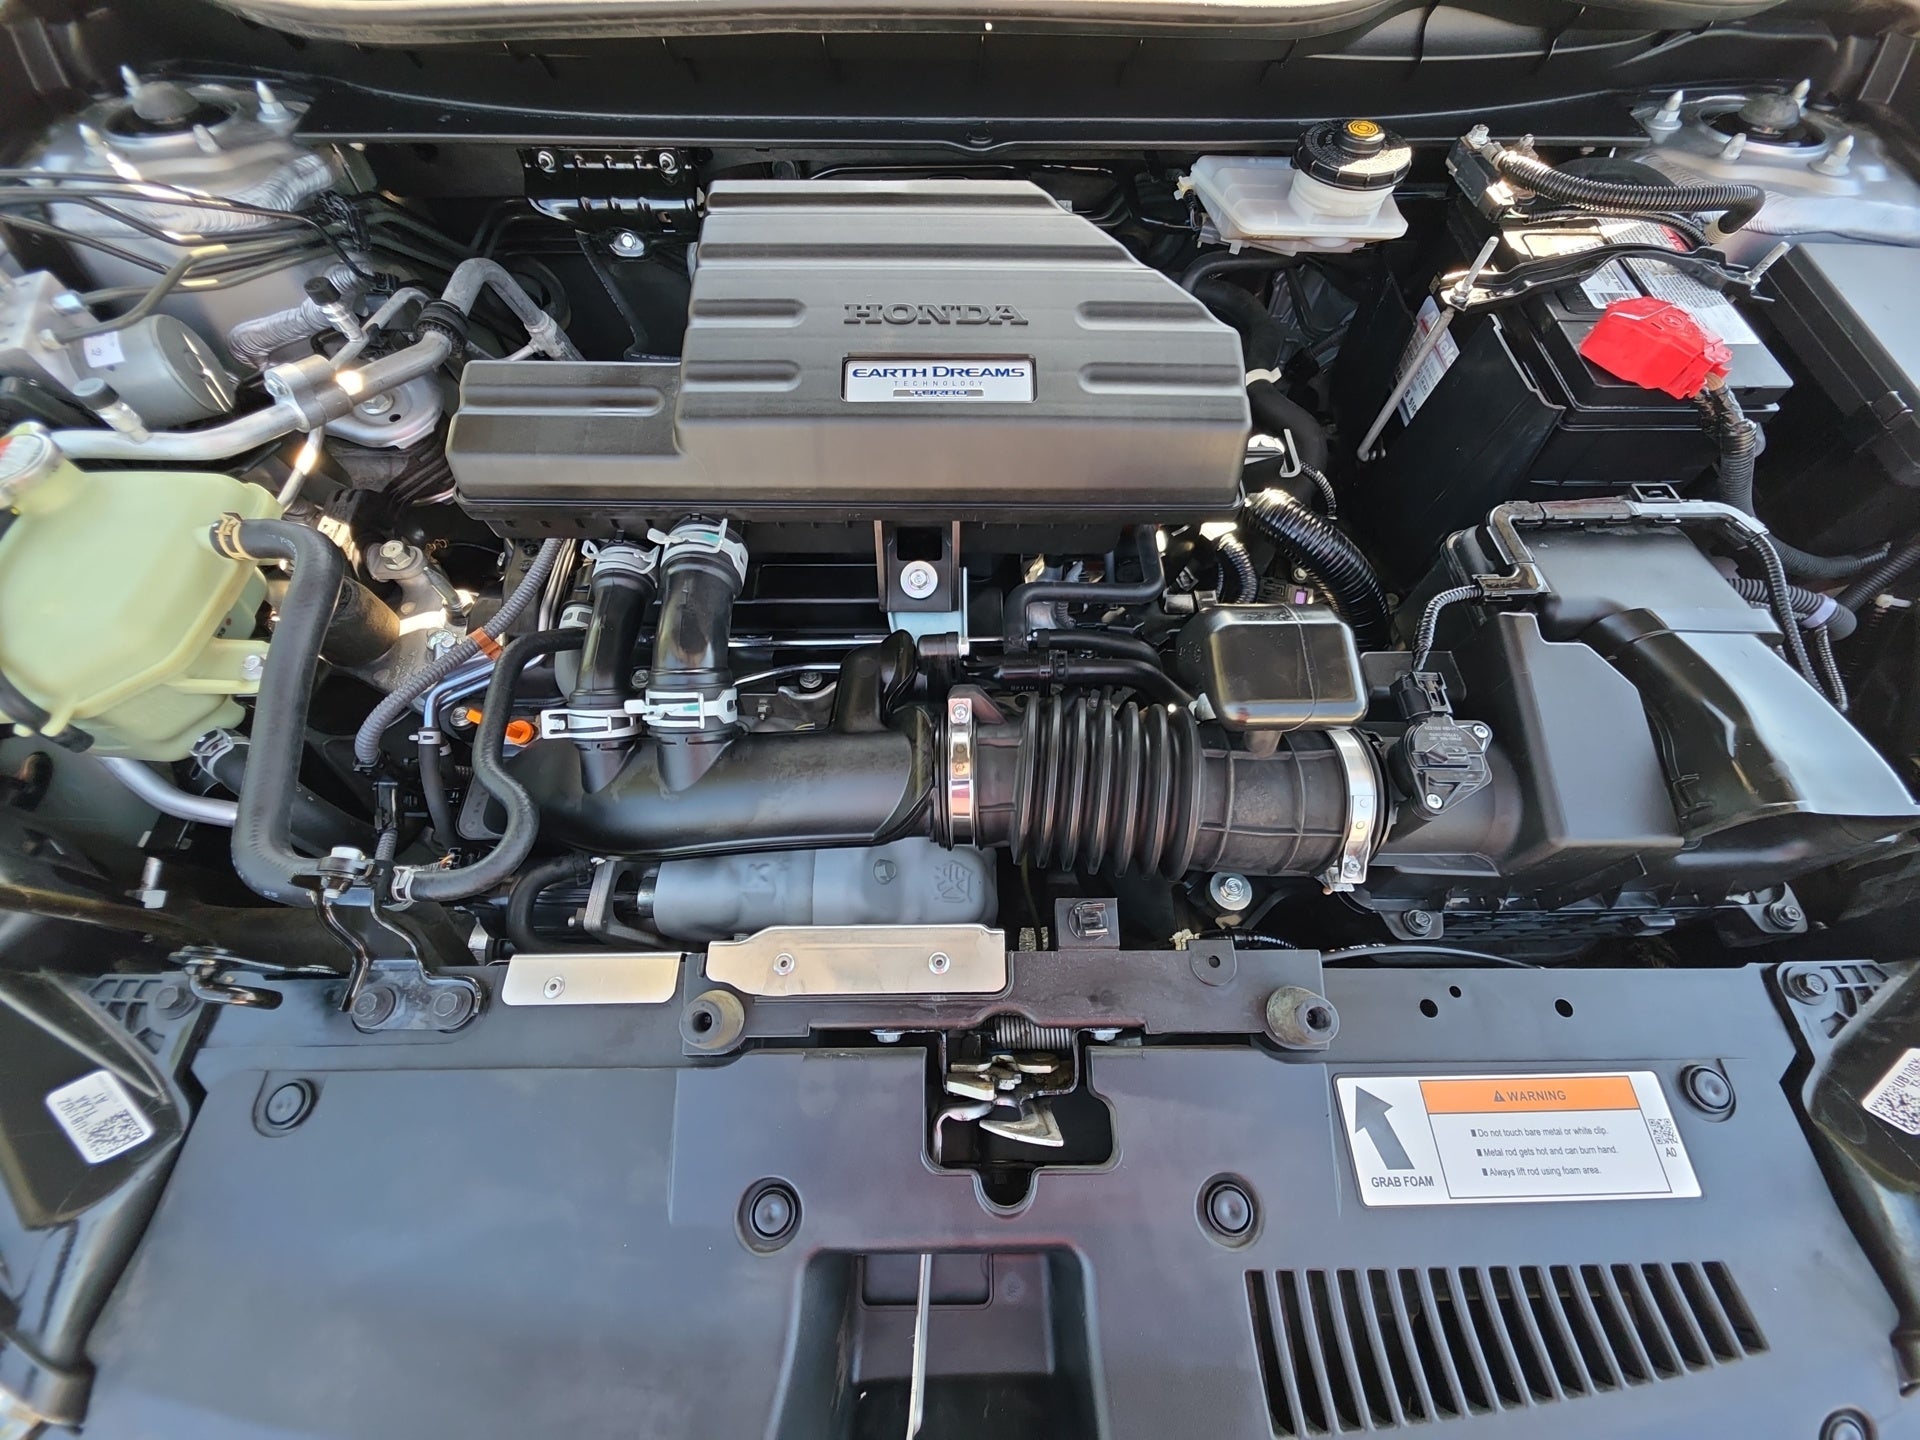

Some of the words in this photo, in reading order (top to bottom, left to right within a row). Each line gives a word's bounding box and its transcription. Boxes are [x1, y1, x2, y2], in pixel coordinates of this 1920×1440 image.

[843, 303, 1029, 325] HONDA
[852, 368, 927, 378] EARTH
[932, 366, 1025, 378] DREAMS
[1506, 1090, 1567, 1102] WARNING
[1477, 1128, 1489, 1137] Do
[1490, 1128, 1502, 1137] not
[1503, 1128, 1524, 1137] touch
[1524, 1127, 1541, 1136] bare
[1543, 1127, 1563, 1136] metal
[1573, 1126, 1592, 1135] white
[1483, 1148, 1504, 1157] Metal
[1505, 1147, 1518, 1157] rod
[1519, 1147, 1535, 1158] gets
[1536, 1147, 1549, 1156] hot
[1549, 1147, 1564, 1155] and
[1565, 1147, 1578, 1155] can
[1579, 1145, 1597, 1155] burn
[1490, 1167, 1516, 1178] Always
[1516, 1167, 1527, 1176] lift
[1527, 1167, 1540, 1176] rod
[1541, 1167, 1562, 1177] using
[1562, 1166, 1581, 1175] foam
[1371, 1176, 1402, 1188] GRAB
[1403, 1175, 1435, 1187] FOAM
